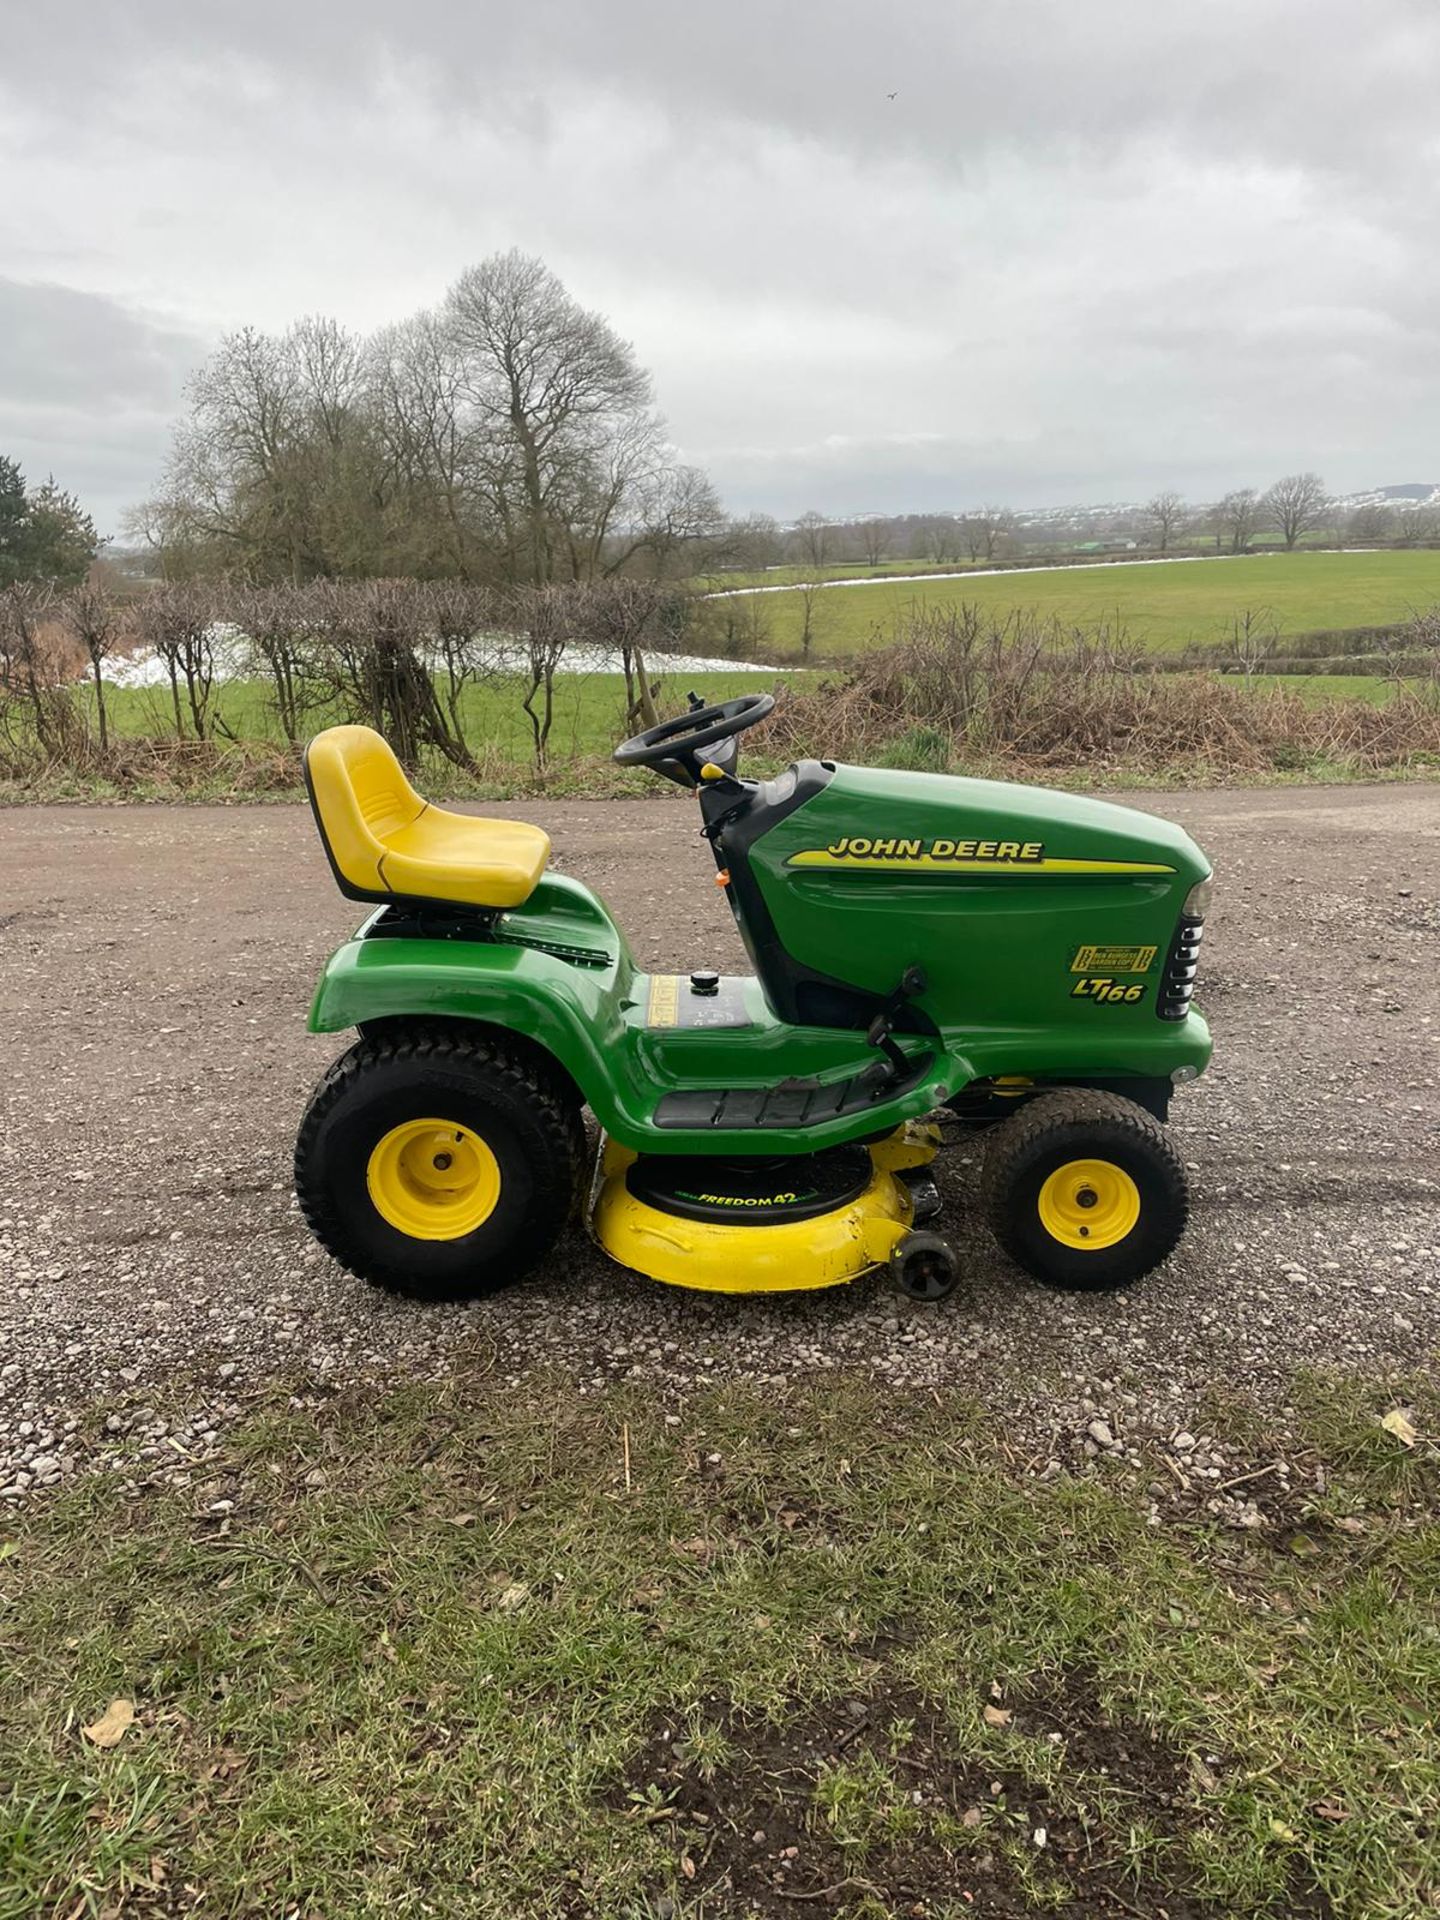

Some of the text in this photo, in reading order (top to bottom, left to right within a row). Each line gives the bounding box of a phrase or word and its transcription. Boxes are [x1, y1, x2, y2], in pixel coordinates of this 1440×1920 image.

[828, 837, 1044, 862] JOHN DEERE
[1071, 978, 1145, 1003] LT166
